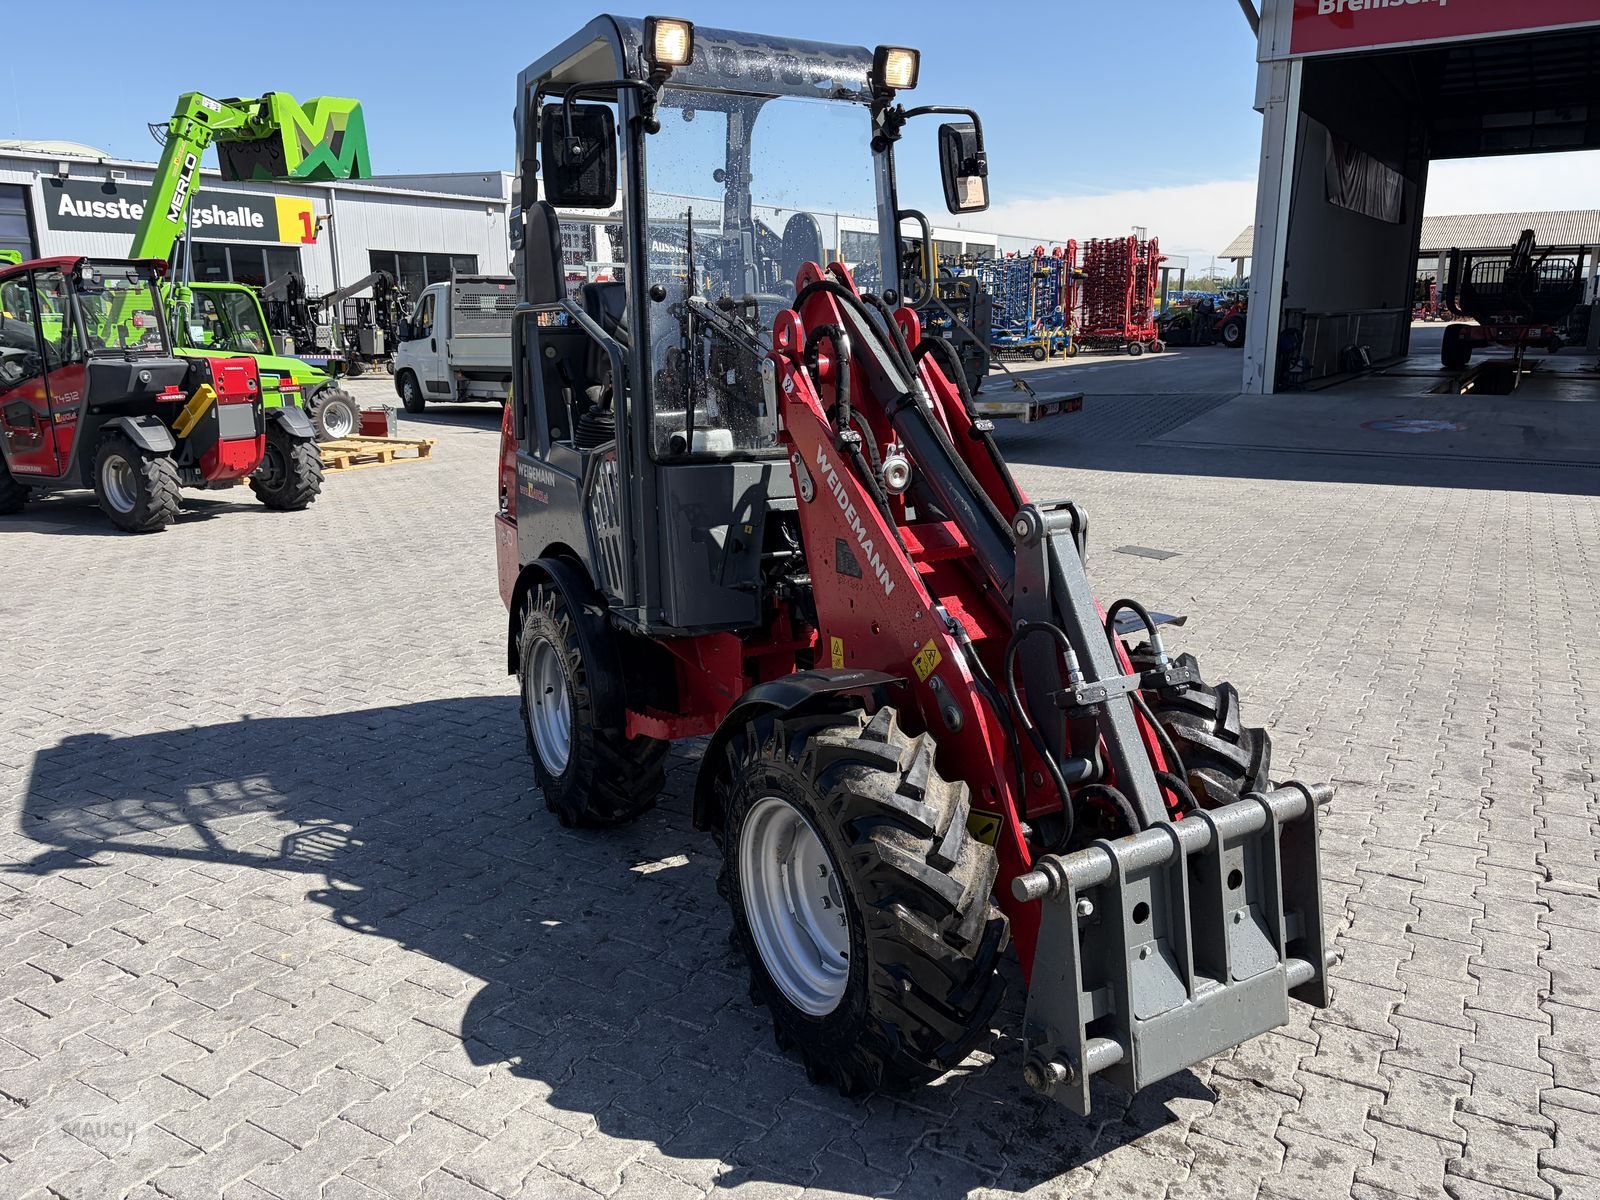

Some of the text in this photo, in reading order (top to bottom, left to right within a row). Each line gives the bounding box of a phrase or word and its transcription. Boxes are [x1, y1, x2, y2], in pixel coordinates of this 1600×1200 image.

[167, 152, 197, 223] MERLO
[58, 193, 317, 244] Ausstegshalle 1
[54, 391, 80, 405] T4512
[517, 462, 555, 487] WEIDEMANN
[815, 443, 895, 597] WEIDEMANN
